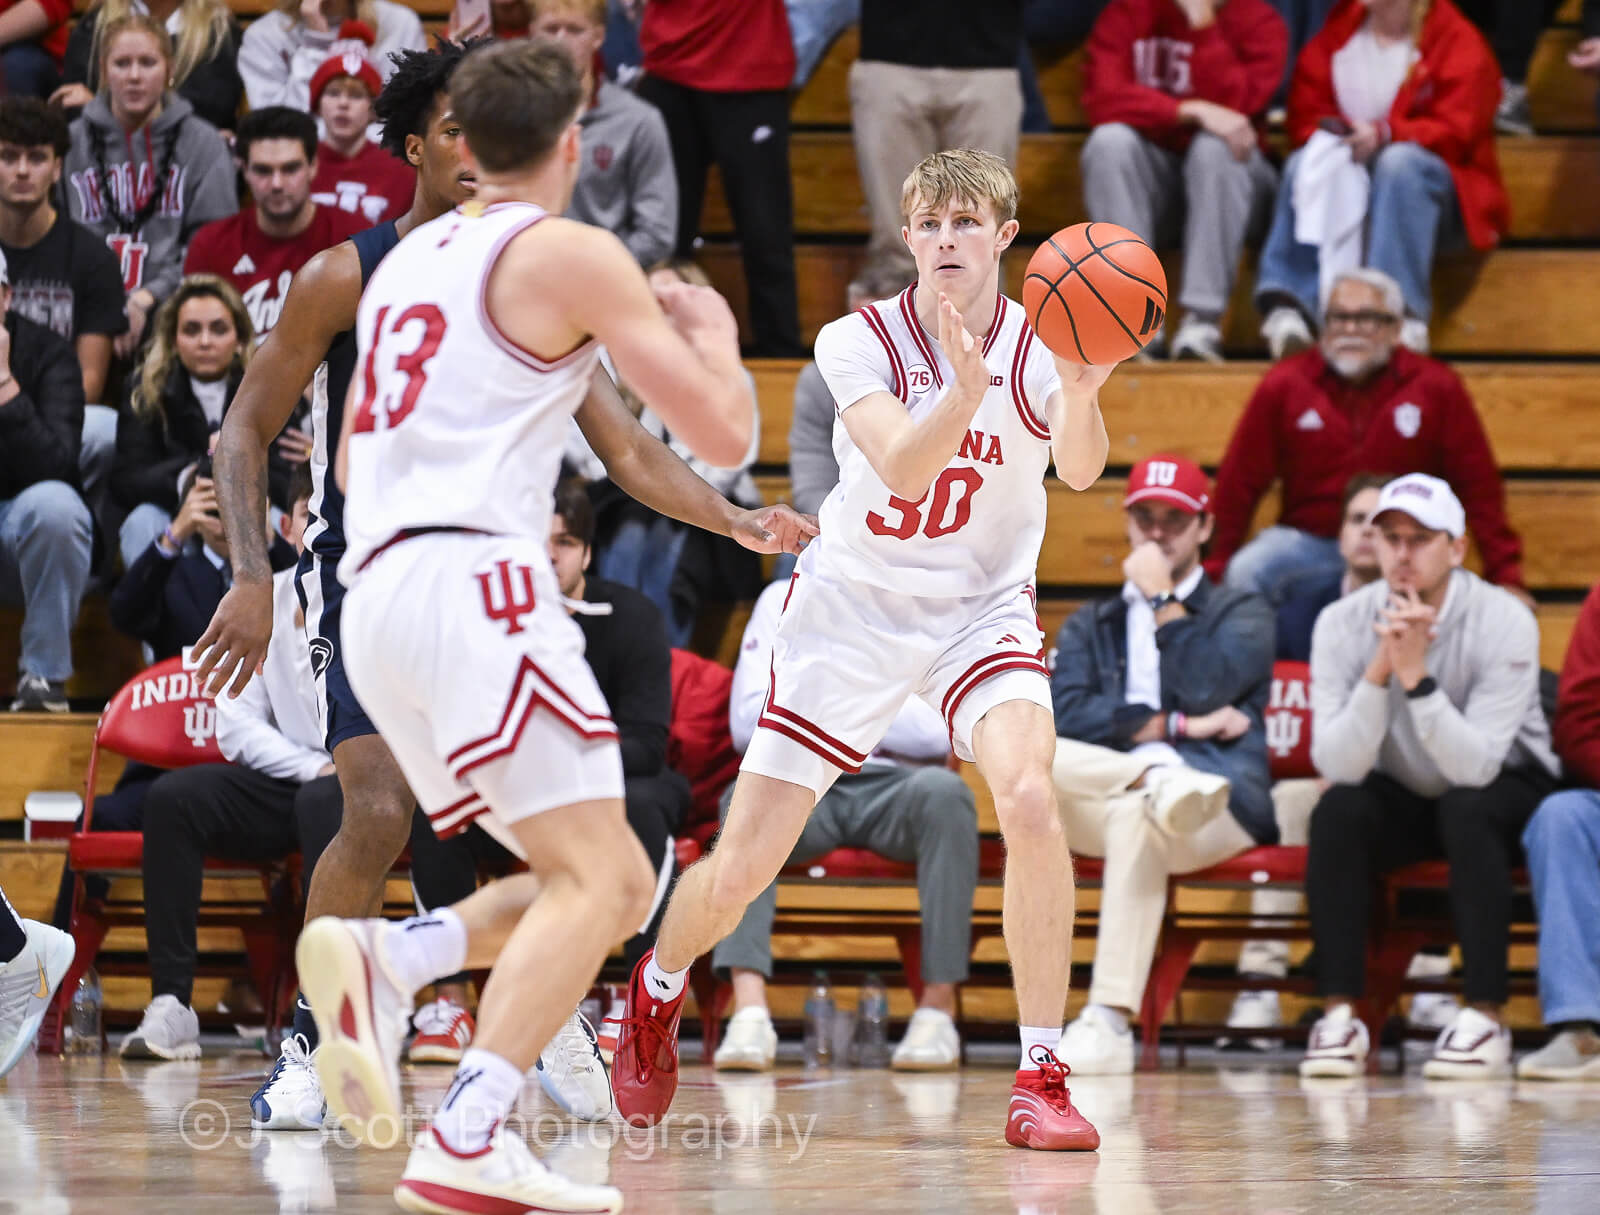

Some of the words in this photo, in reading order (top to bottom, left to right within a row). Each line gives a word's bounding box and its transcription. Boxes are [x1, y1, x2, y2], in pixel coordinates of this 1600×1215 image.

[352, 303, 447, 434] 13
[909, 371, 930, 387] 76
[955, 428, 1004, 466] NA
[1144, 461, 1178, 487] IU
[866, 467, 984, 541] 30
